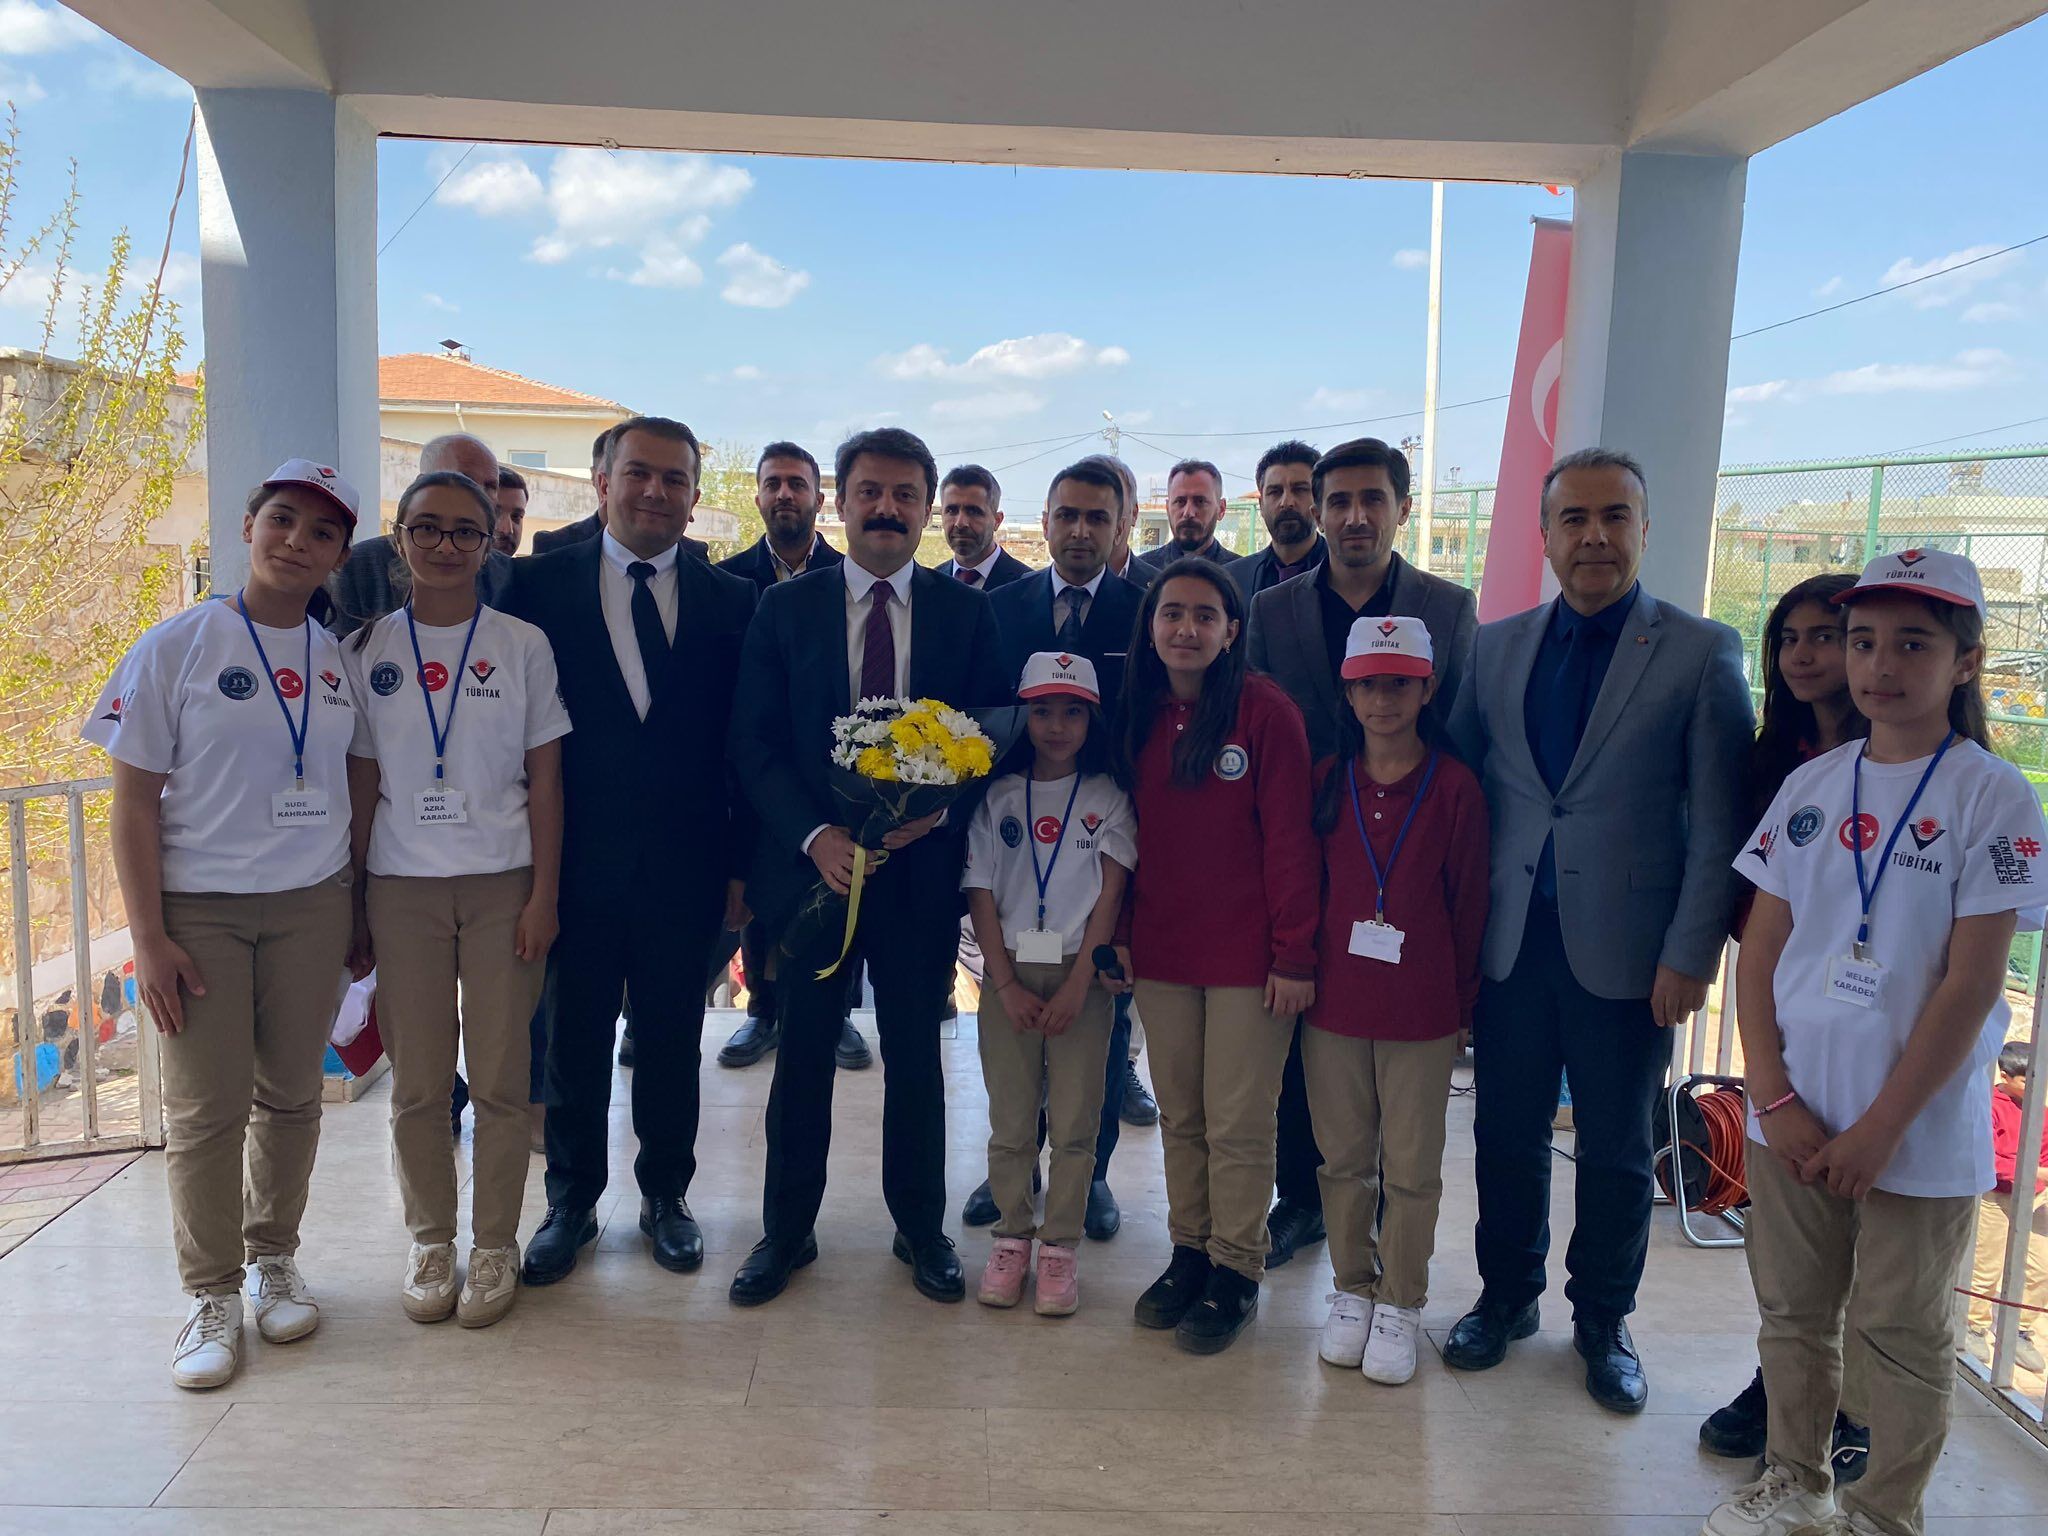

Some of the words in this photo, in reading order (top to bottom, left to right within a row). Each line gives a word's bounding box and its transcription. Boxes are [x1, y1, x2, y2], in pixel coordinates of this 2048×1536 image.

[465, 686, 501, 699] TÜBİTAK
[277, 810, 327, 818] KAHRAMAN
[420, 813, 459, 821] KARADAĞ
[1893, 851, 1943, 875] TÜBİTAK
[1845, 970, 1877, 987] MELEK
